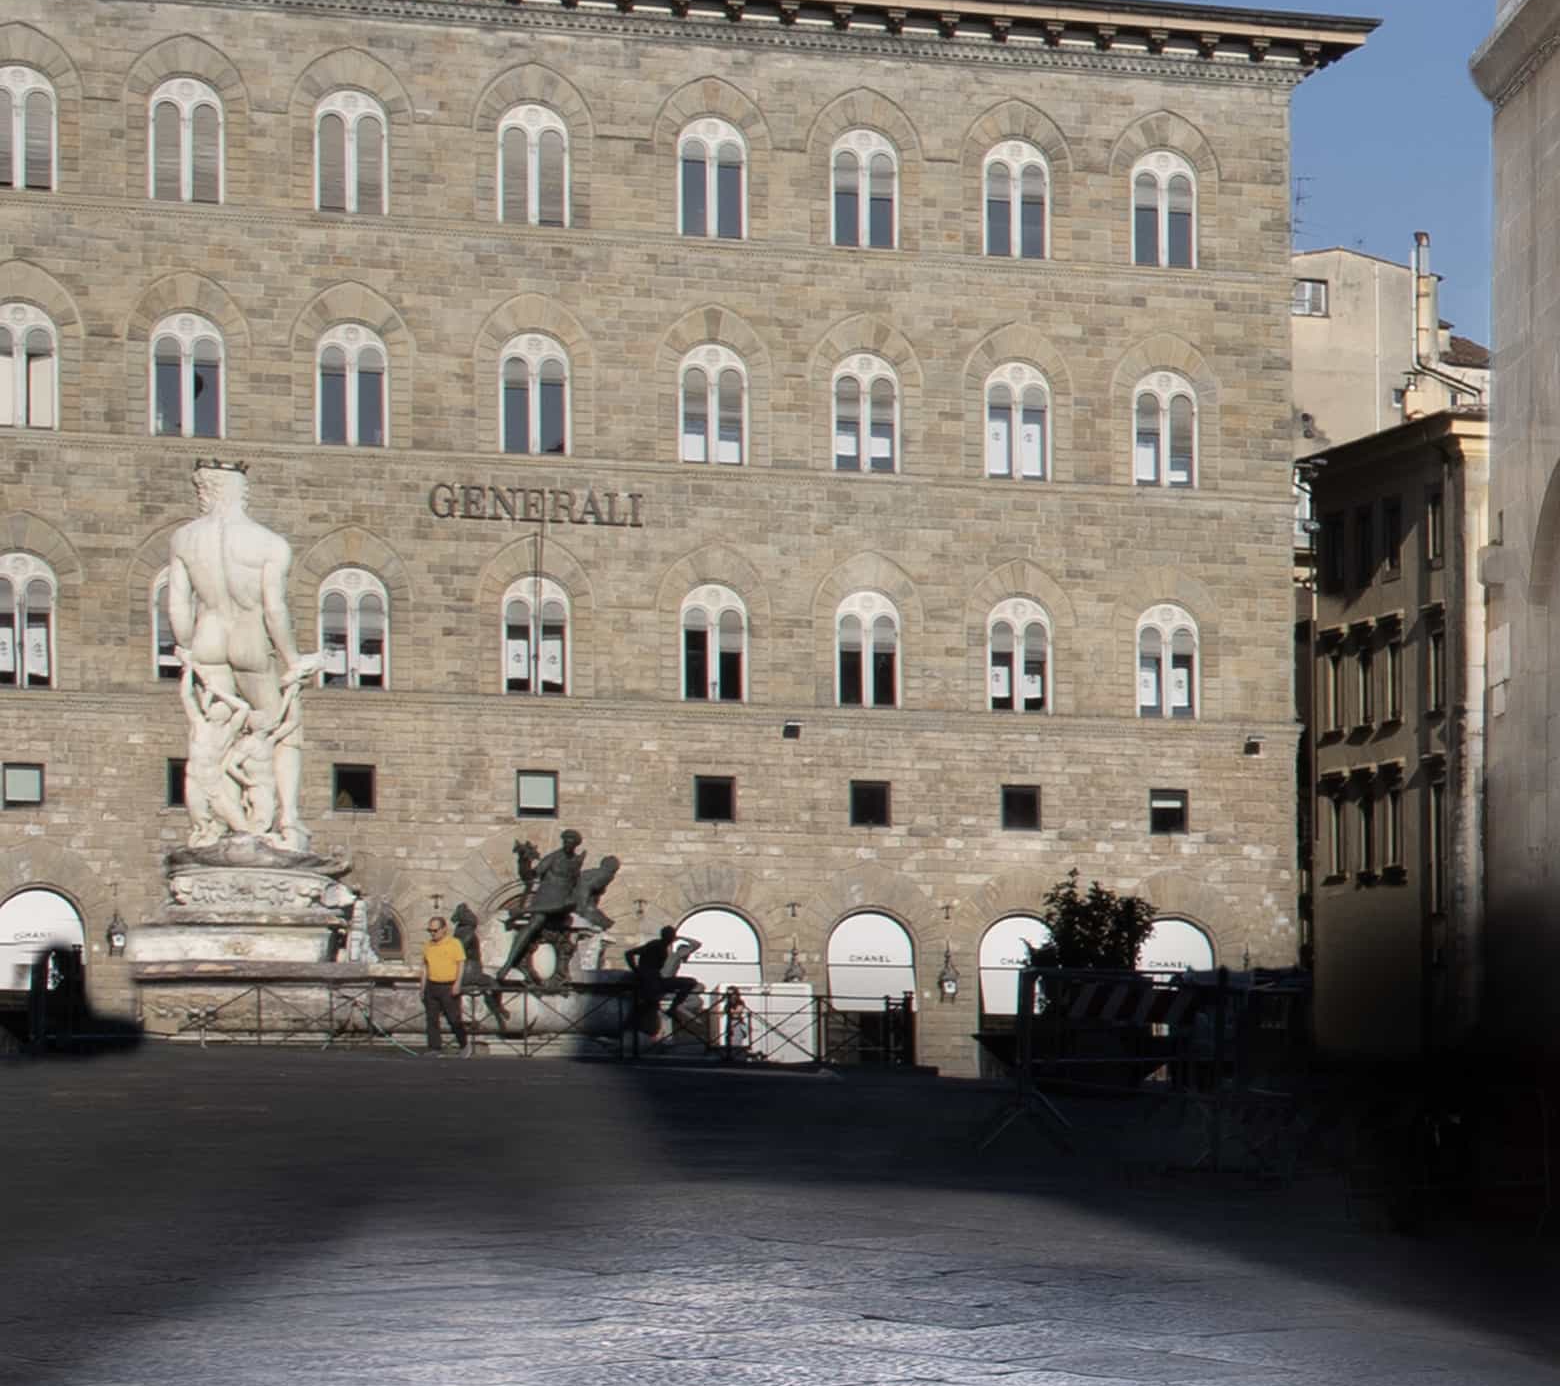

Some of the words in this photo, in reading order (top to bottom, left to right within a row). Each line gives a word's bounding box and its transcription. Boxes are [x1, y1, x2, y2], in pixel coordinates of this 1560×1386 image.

[429, 482, 643, 527] GENERALI
[694, 951, 738, 961] CHANEL
[849, 954, 892, 963] CHANEL
